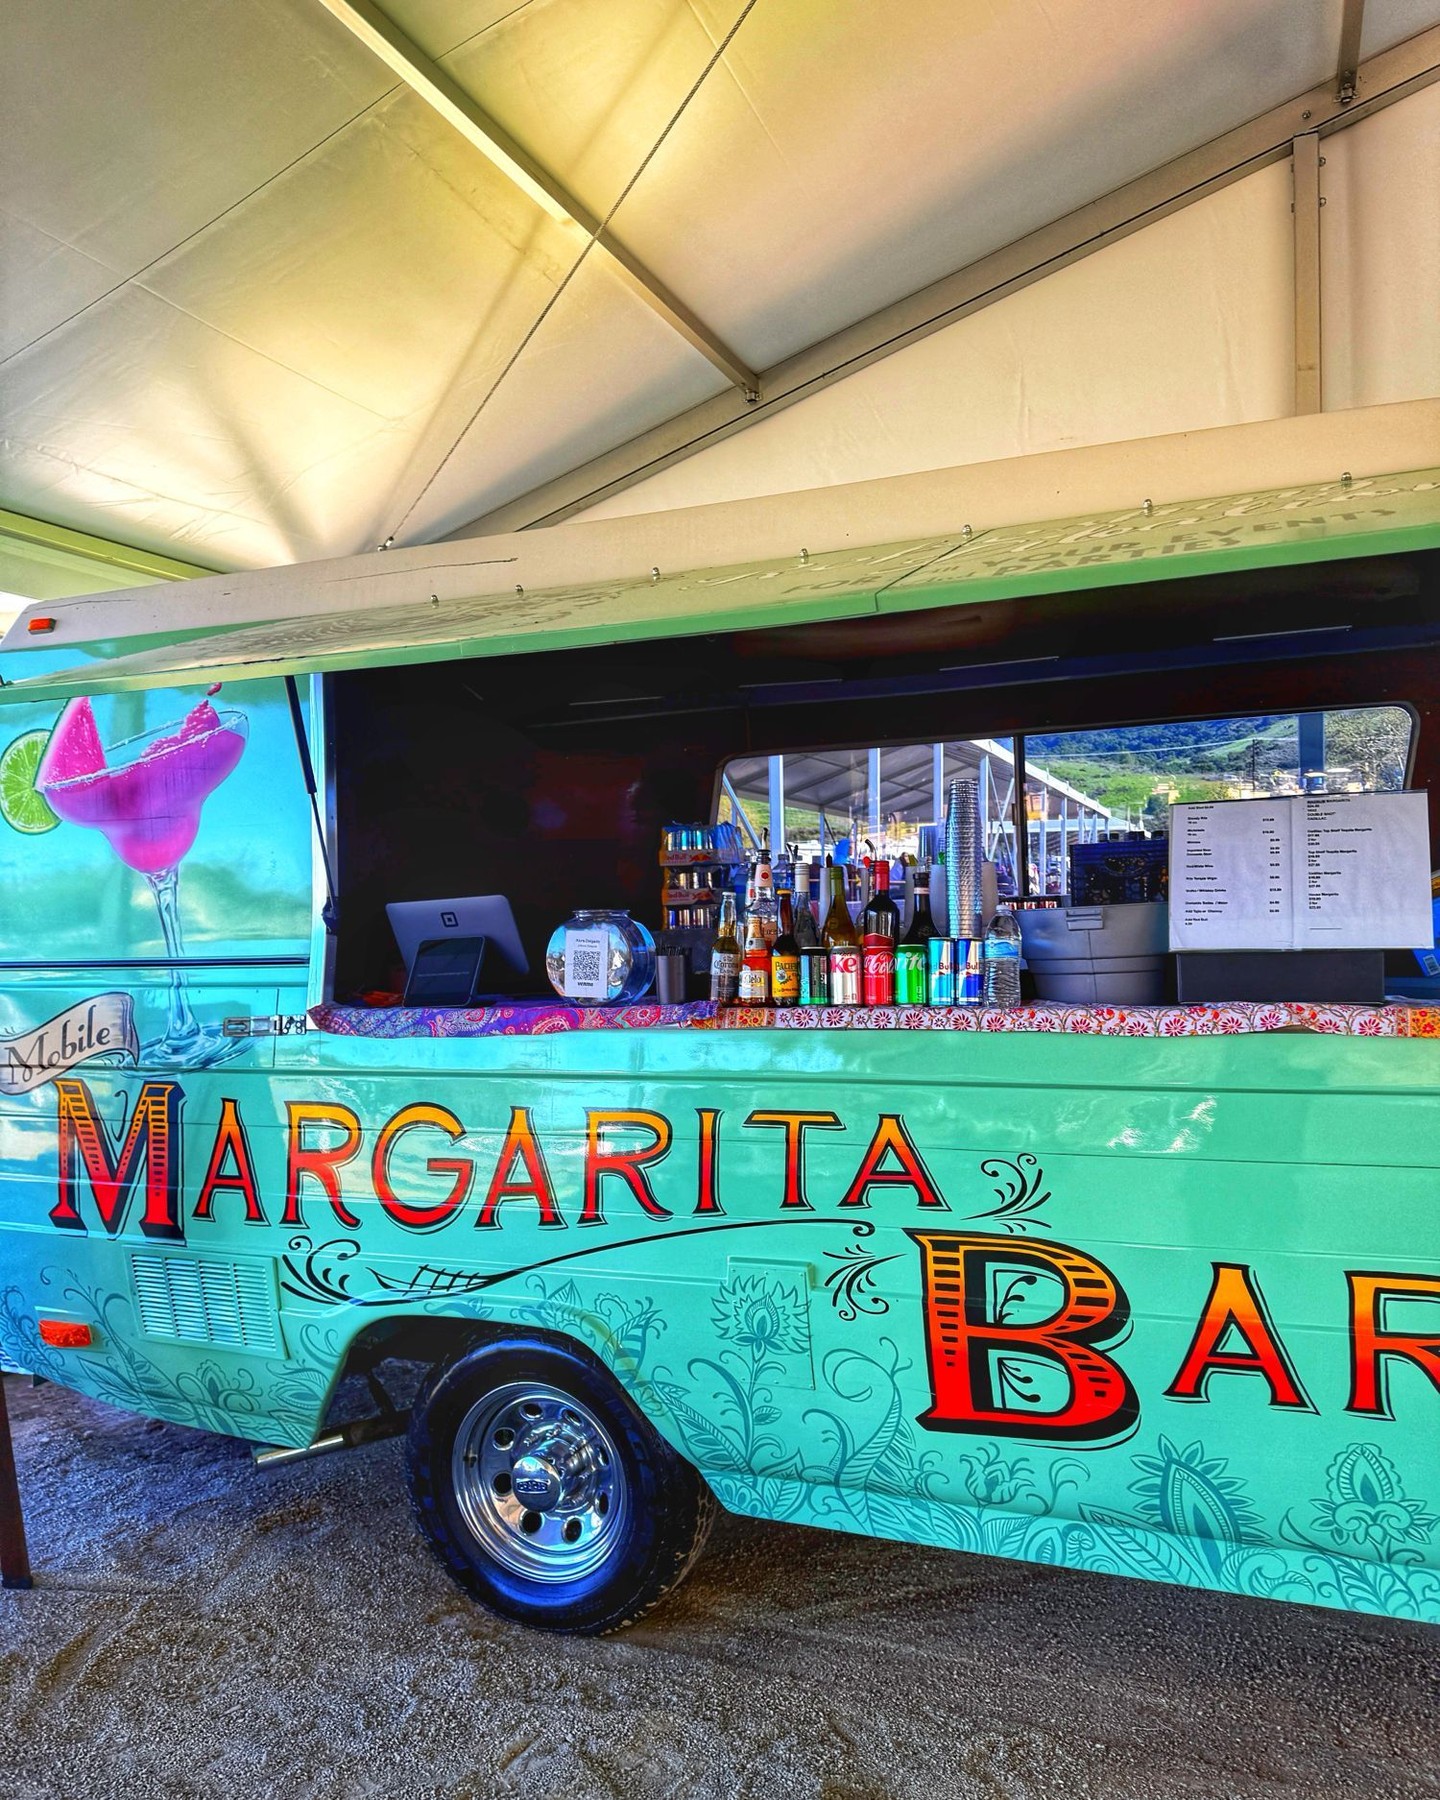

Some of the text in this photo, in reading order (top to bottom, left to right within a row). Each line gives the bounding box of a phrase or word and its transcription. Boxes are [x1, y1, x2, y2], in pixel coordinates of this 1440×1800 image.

[981, 542, 1142, 567] YOUR
[1169, 509, 1397, 543] EVENTS
[992, 536, 1240, 576] PARTIES
[3, 1004, 111, 1086] Mobile
[48, 1077, 952, 1248] MARGARITA
[902, 1228, 1440, 1452] BAR
